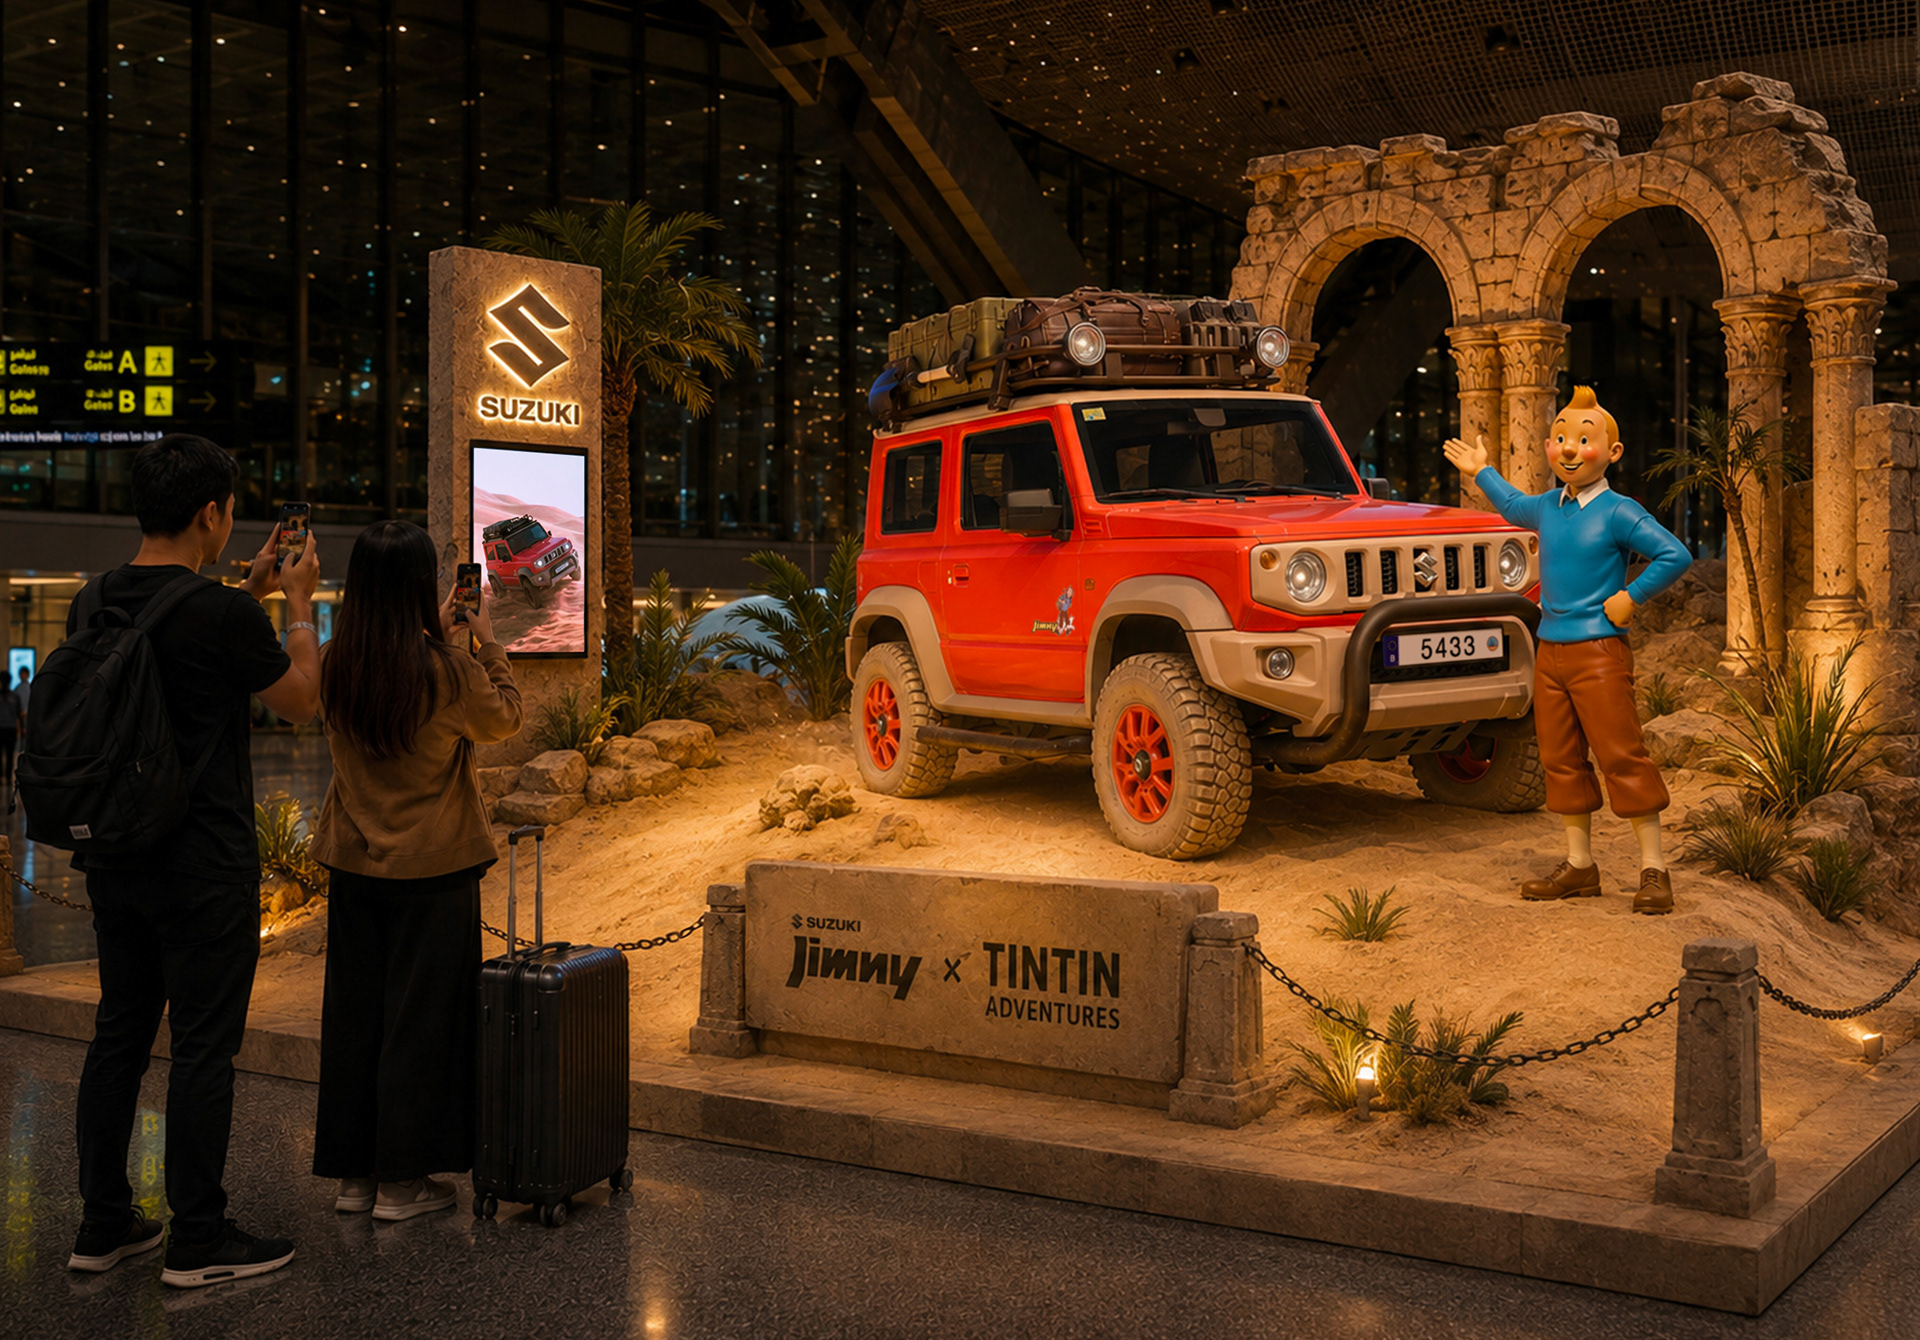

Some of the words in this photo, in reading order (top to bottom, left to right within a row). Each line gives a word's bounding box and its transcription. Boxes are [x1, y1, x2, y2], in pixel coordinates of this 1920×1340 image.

[118, 350, 137, 374] A
[119, 389, 136, 413] B
[479, 395, 581, 426] SUZUKI
[1389, 654, 1396, 663] B
[1421, 635, 1475, 660] 5433
[806, 916, 861, 932] SUZUKI
[785, 935, 923, 1001] Jimny
[983, 941, 1120, 998] TINTIN
[985, 995, 1120, 1030] ADVENTURES
